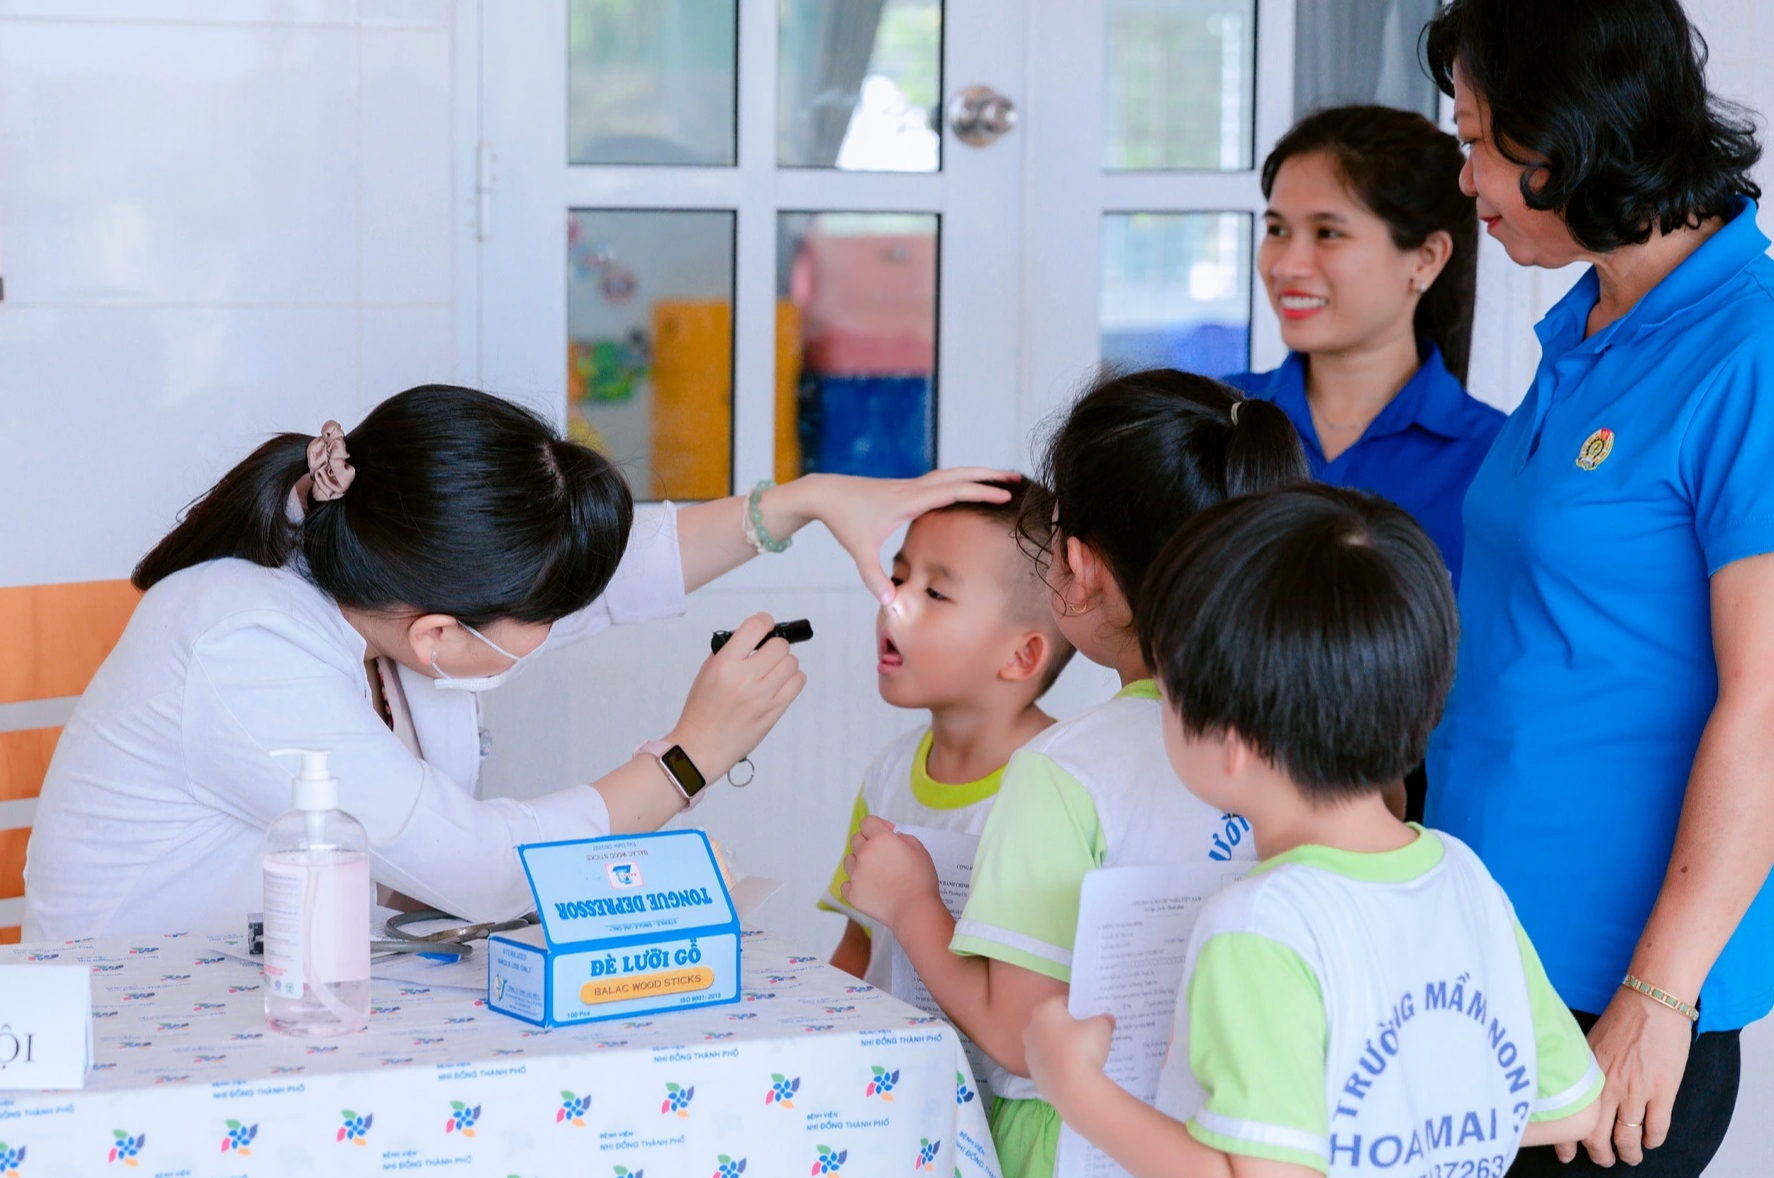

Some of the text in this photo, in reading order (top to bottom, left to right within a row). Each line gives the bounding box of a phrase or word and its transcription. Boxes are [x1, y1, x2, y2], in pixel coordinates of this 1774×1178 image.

[586, 853, 608, 861] STICKS
[555, 887, 713, 920] TONGUE DEPRESSOR
[590, 938, 702, 977] ĐÈ LƯỠI GỖ
[594, 974, 702, 997] BALAC WOOD STICKS
[567, 1011, 579, 1019] 100
[875, 1036, 898, 1046] ĐỒNG
[899, 1036, 925, 1044] THÀNH
[926, 1033, 943, 1042] PHỐ
[1334, 992, 1416, 1121] TRƯỜNG
[1425, 971, 1487, 1026] MẦM
[1487, 1017, 1531, 1095] NON
[669, 1052, 692, 1062] ĐỒNG
[694, 1051, 721, 1060] THÀNH
[722, 1048, 739, 1057] PHỐ
[454, 1070, 478, 1080] ĐỒNG
[480, 1068, 508, 1077] THÀNH
[509, 1065, 527, 1075] PHỐ
[229, 1089, 254, 1099] ĐỒNG
[257, 1086, 285, 1096] THÀNH
[287, 1083, 306, 1093] PHỐ
[25, 1107, 54, 1117] THÀNH
[56, 1103, 75, 1114] PHỐ
[820, 1120, 843, 1130] ĐỒNG
[845, 1120, 872, 1129] THÀNH
[873, 1117, 890, 1127] PHỐ
[615, 1140, 639, 1150] ĐỒNG
[641, 1139, 668, 1148] THÀNH
[669, 1135, 686, 1145] PHỐ
[1329, 1107, 1498, 1169] HOA MAI
[955, 1140, 966, 1152] NHI
[965, 1150, 984, 1168] ĐỒNG
[398, 1160, 422, 1170] ĐỒNG
[425, 1158, 453, 1167] THÀNH
[455, 1154, 472, 1164] PHỐ
